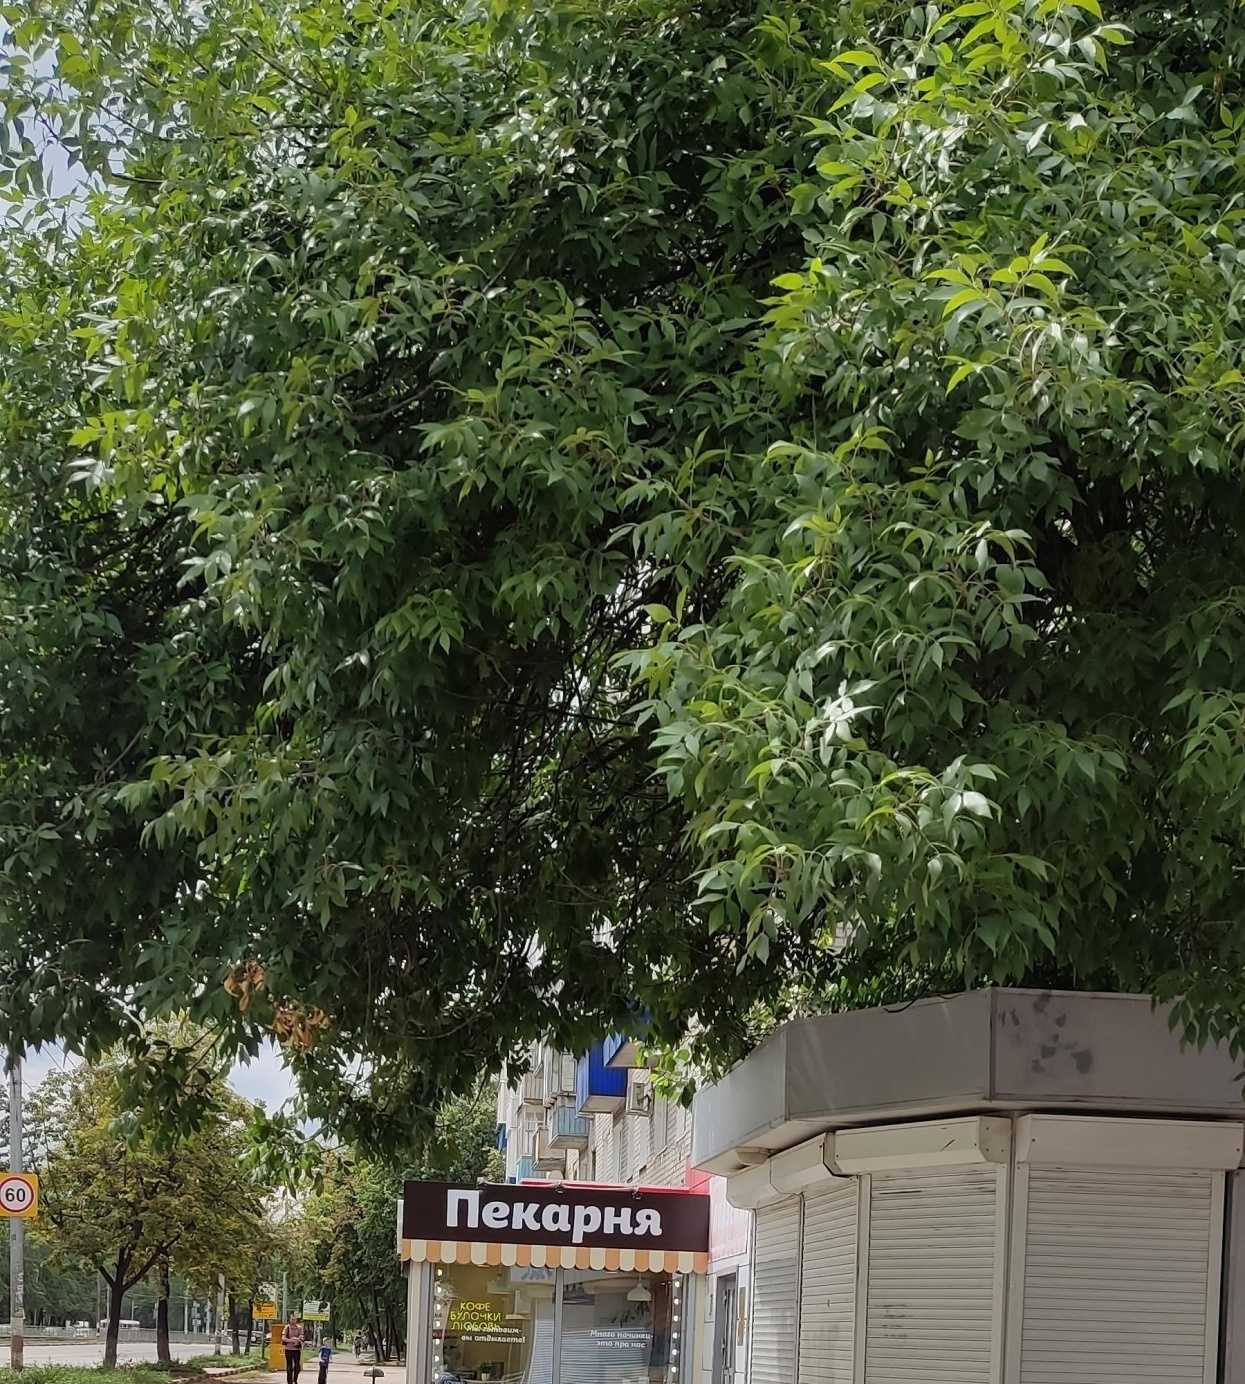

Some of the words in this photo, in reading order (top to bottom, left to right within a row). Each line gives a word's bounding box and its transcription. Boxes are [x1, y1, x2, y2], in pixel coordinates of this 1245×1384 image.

[5, 1187, 26, 1202] 60
[447, 1189, 662, 1243] Пекарня
[460, 1302, 491, 1311] КОФЕ
[450, 1311, 501, 1321] БУЛОЧКИ
